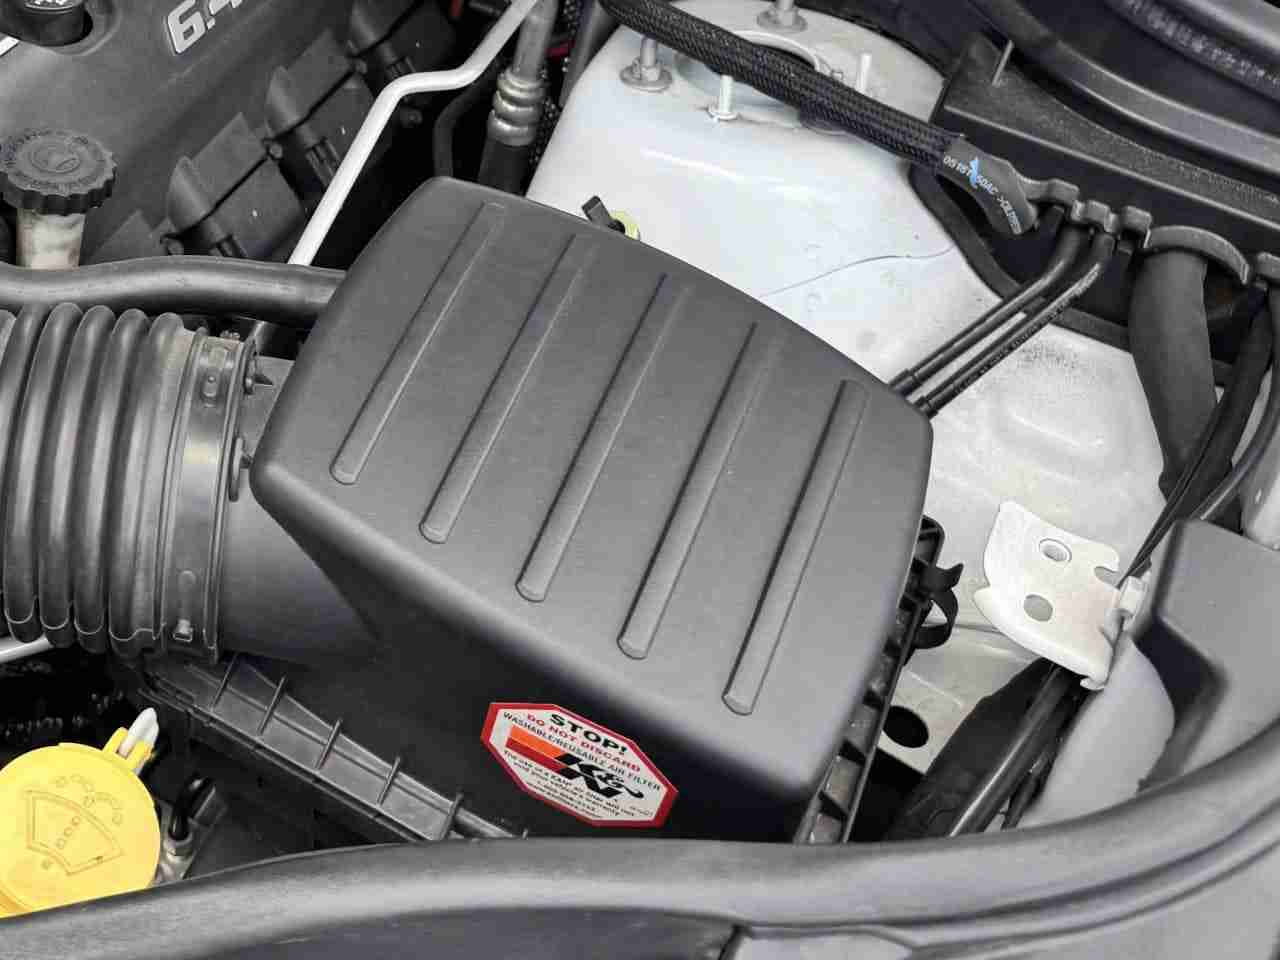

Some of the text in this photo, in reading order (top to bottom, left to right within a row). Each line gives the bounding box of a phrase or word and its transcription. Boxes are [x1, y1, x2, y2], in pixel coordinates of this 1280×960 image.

[528, 713, 640, 772] DO NOT DISCARD
[550, 713, 627, 755] STOP!
[608, 764, 625, 776] AIR
[627, 771, 660, 791] FILTER
